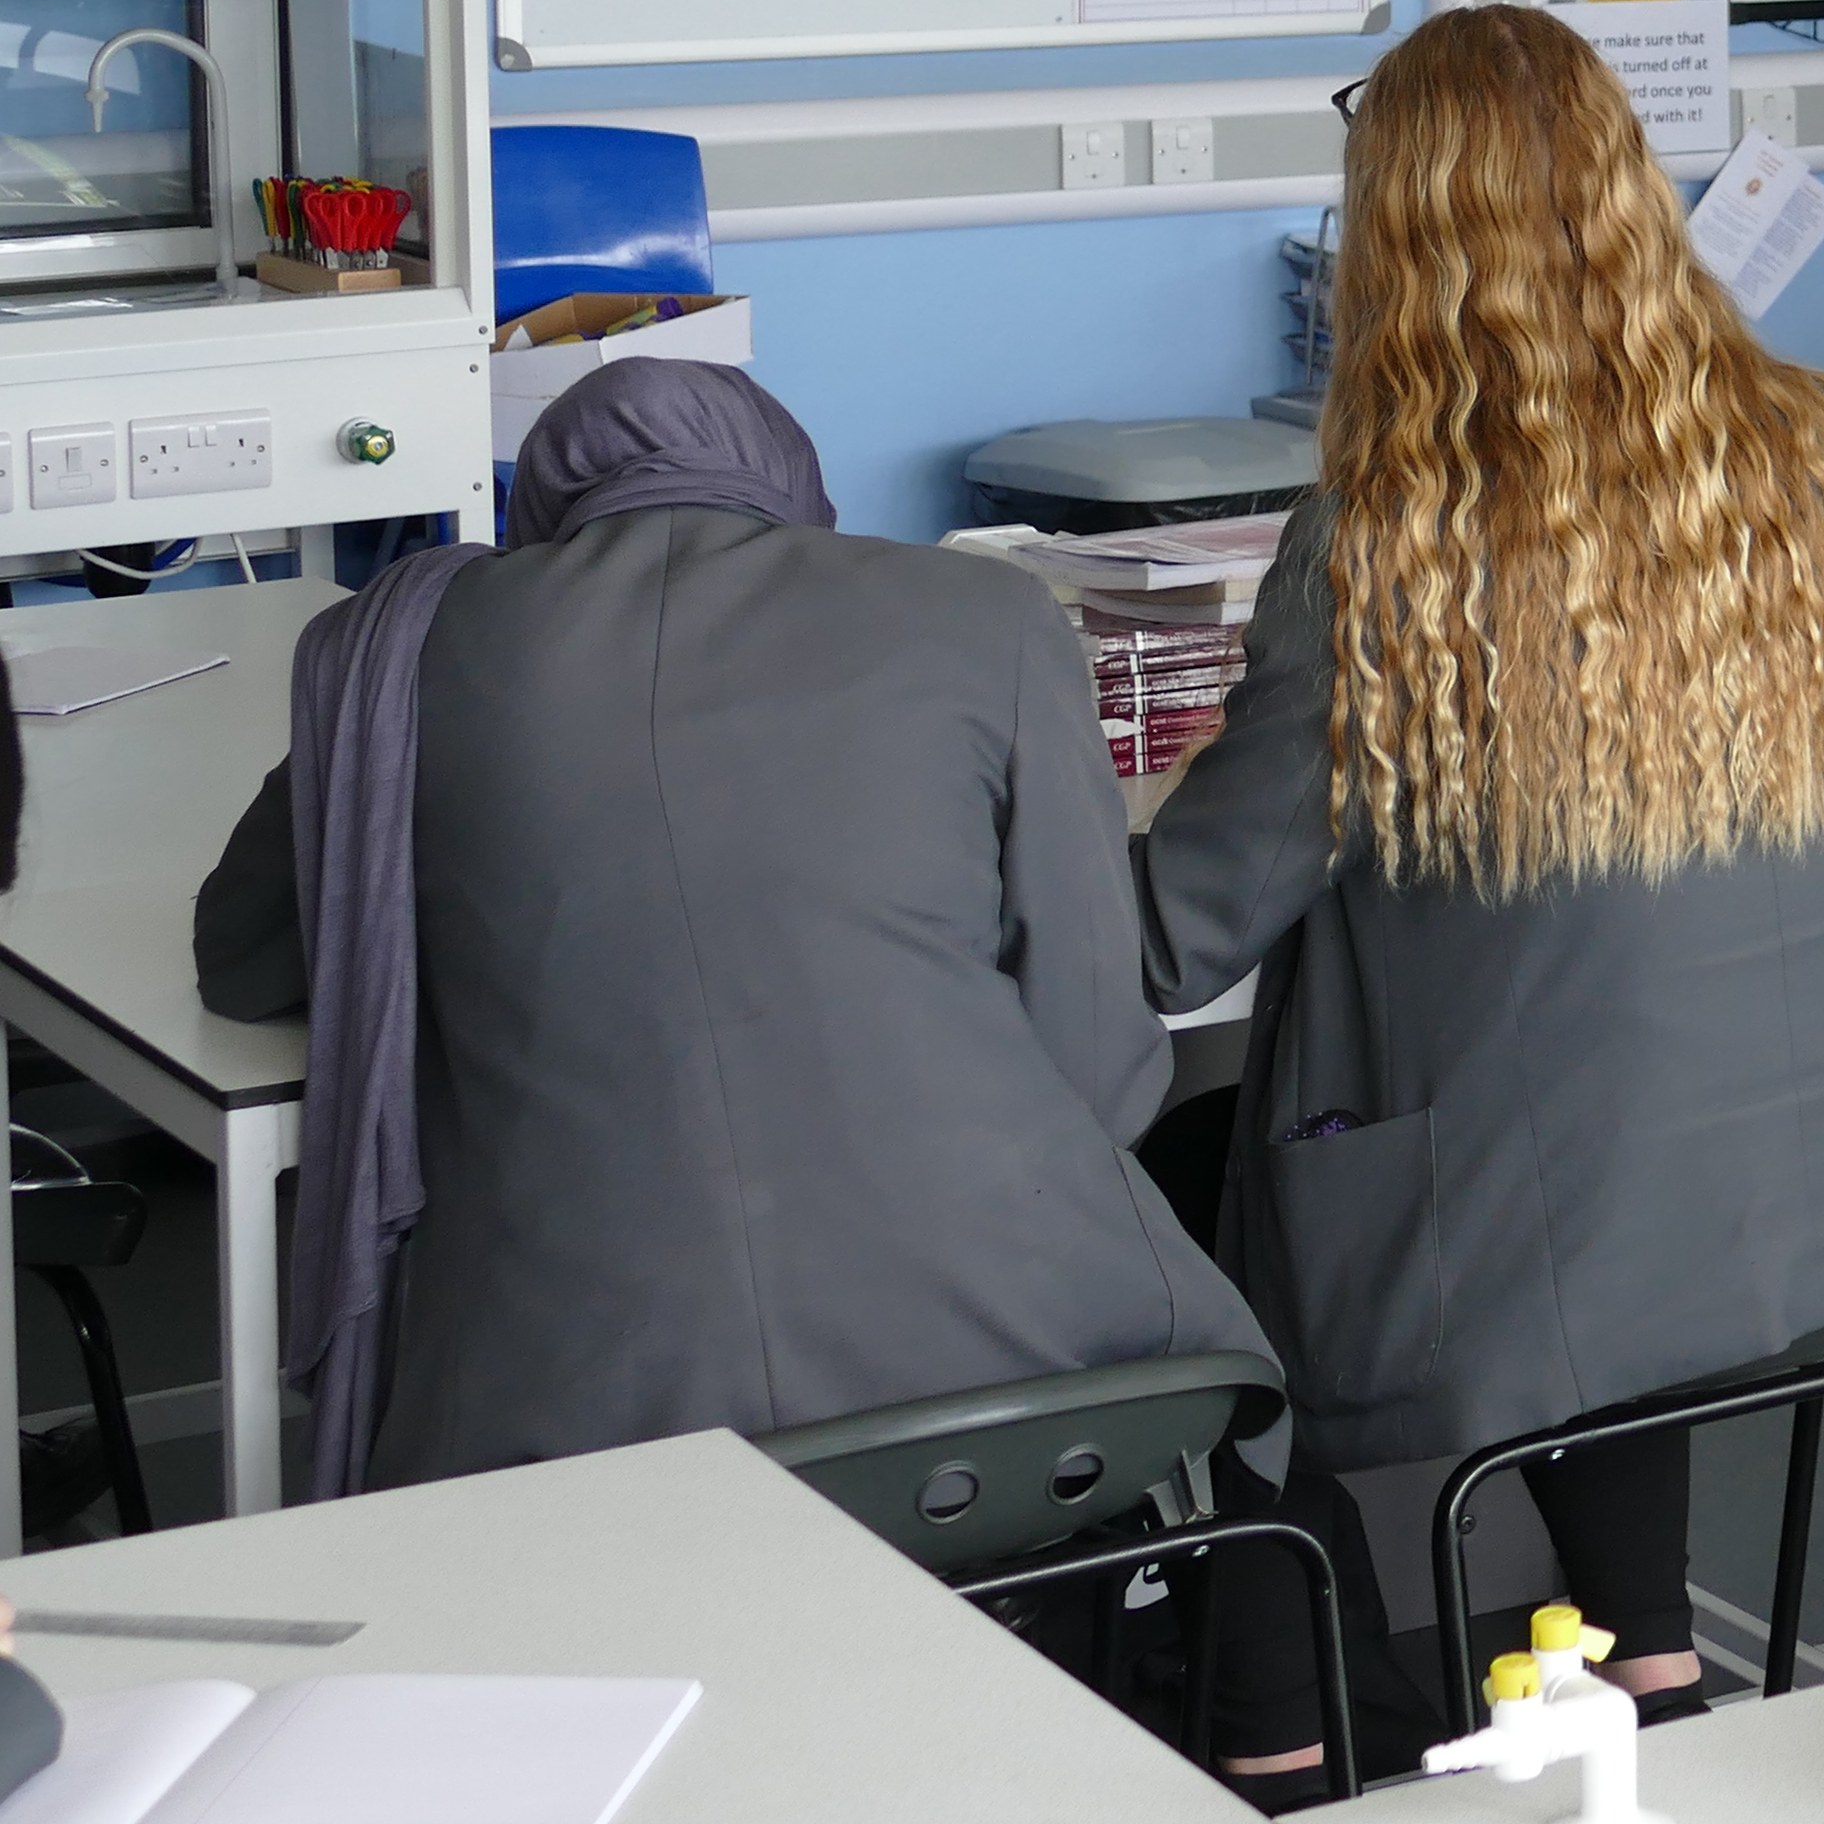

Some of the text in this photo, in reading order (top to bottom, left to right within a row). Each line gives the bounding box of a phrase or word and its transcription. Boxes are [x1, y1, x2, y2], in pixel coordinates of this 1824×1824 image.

[1604, 32, 1704, 48] make sure that
[1623, 57, 1708, 73] turned off at
[1651, 85, 1712, 99] once you
[1654, 108, 1702, 123] with it!
[1113, 705, 1131, 713] CGP
[1113, 742, 1131, 751] CGP
